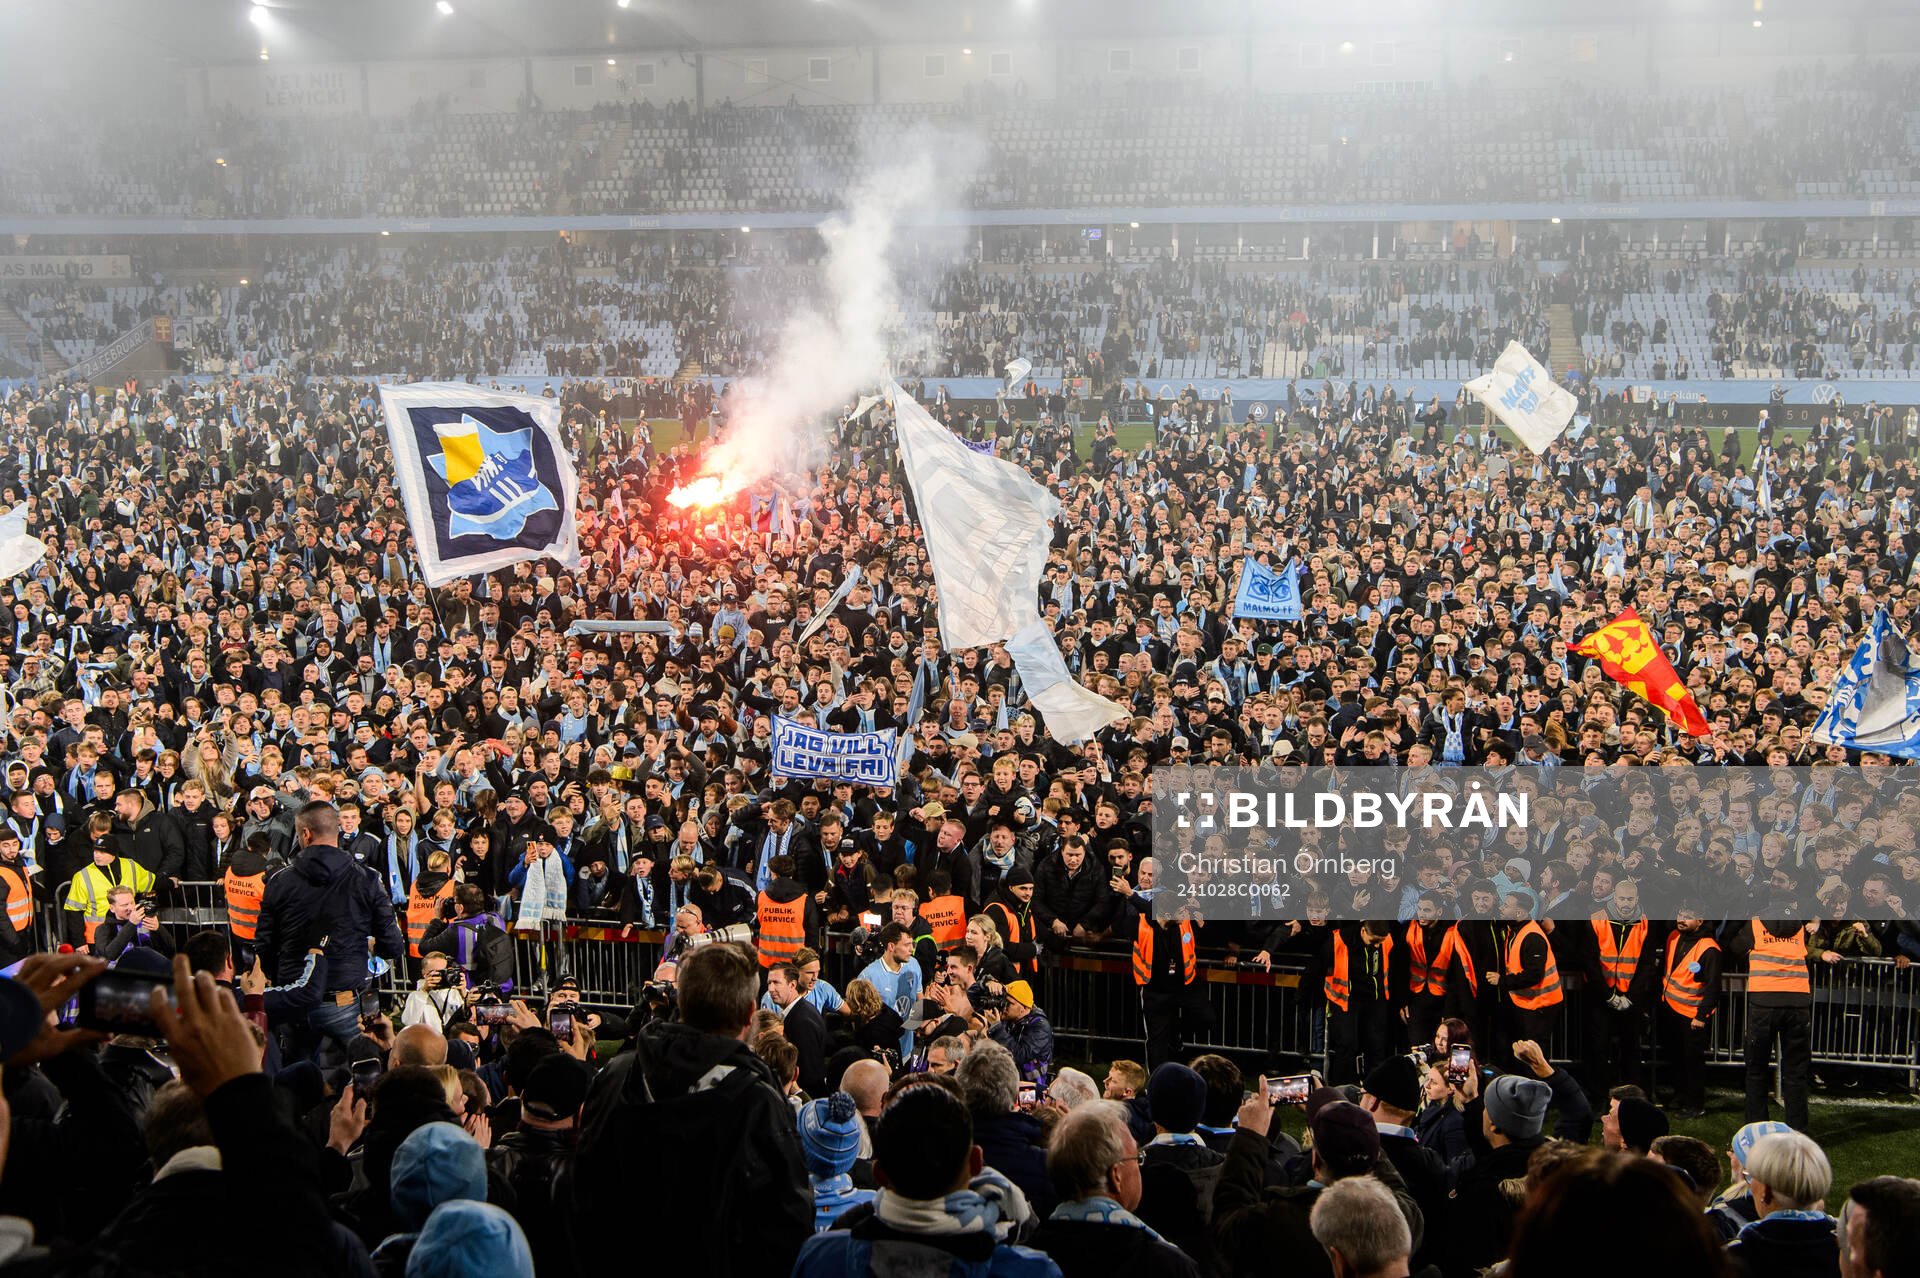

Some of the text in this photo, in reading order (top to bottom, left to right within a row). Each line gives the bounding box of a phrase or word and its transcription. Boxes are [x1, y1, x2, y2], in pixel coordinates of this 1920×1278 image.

[31, 264, 93, 276] MALØ
[973, 404, 1017, 414] 203
[783, 730, 881, 755] JAG VILL
[780, 750, 883, 776] LEVA FRI
[229, 879, 255, 889] PUBLIK-
[228, 887, 255, 898] SERVICE
[413, 902, 434, 910] SERVI
[763, 915, 796, 923] SERVICE
[925, 910, 957, 920] PUBLIK-
[930, 918, 959, 928] ERVICE
